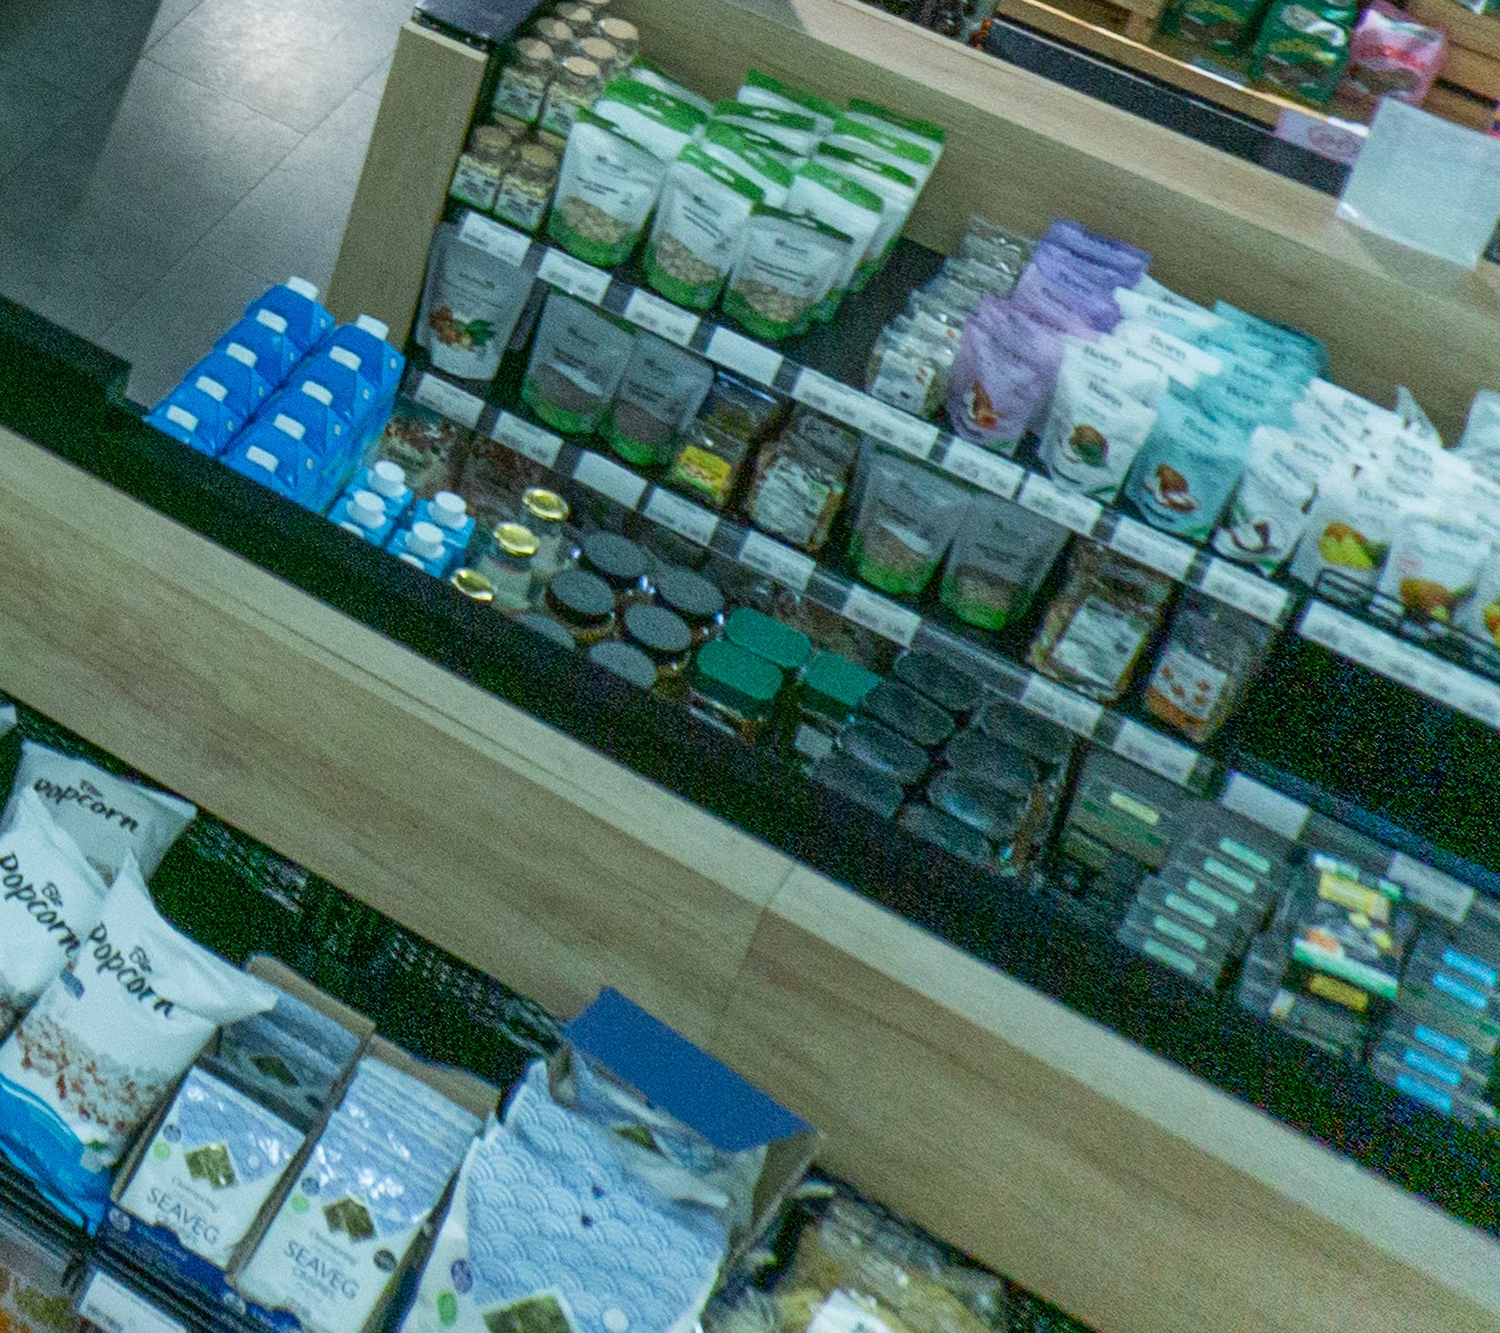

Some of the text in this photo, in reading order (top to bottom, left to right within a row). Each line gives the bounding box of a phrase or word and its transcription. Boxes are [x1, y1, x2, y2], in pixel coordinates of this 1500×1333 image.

[33, 778, 139, 833] Popcorn
[0, 852, 80, 954] Popcorn
[90, 920, 177, 1019] Popcorn
[148, 1186, 221, 1244] SEAVEG
[284, 1239, 359, 1300] SEAVEG
